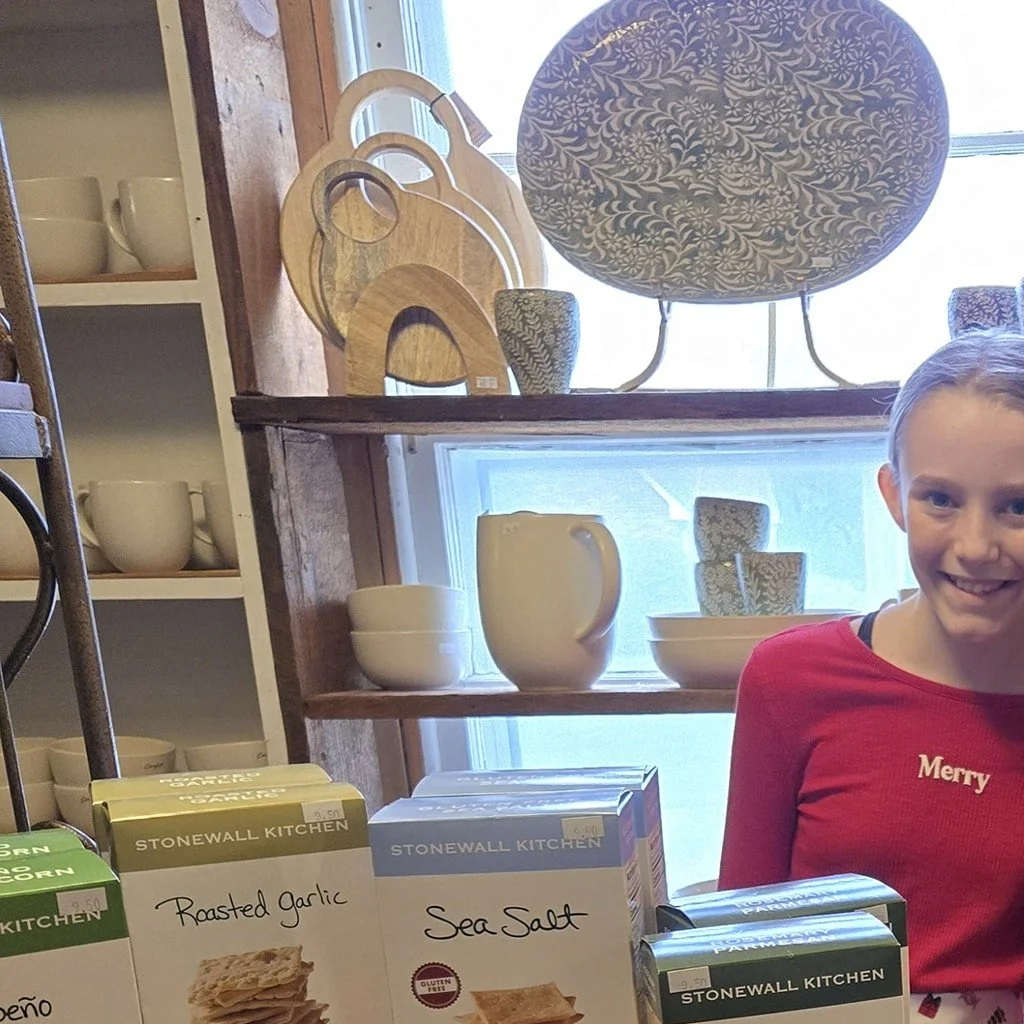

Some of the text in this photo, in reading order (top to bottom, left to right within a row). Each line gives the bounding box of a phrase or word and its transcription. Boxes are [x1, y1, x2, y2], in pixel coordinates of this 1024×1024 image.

[918, 753, 992, 795] Merry
[135, 819, 350, 852] STONEWALL KITCHEN
[391, 837, 602, 857] STONEWALL KITCHEN
[0, 911, 101, 935] KITCHEN
[155, 889, 270, 927] Roasted
[424, 904, 588, 940] Sea Salt
[421, 979, 451, 987] GLUTEN
[681, 968, 885, 1004] STONEWALL KITCHEN
